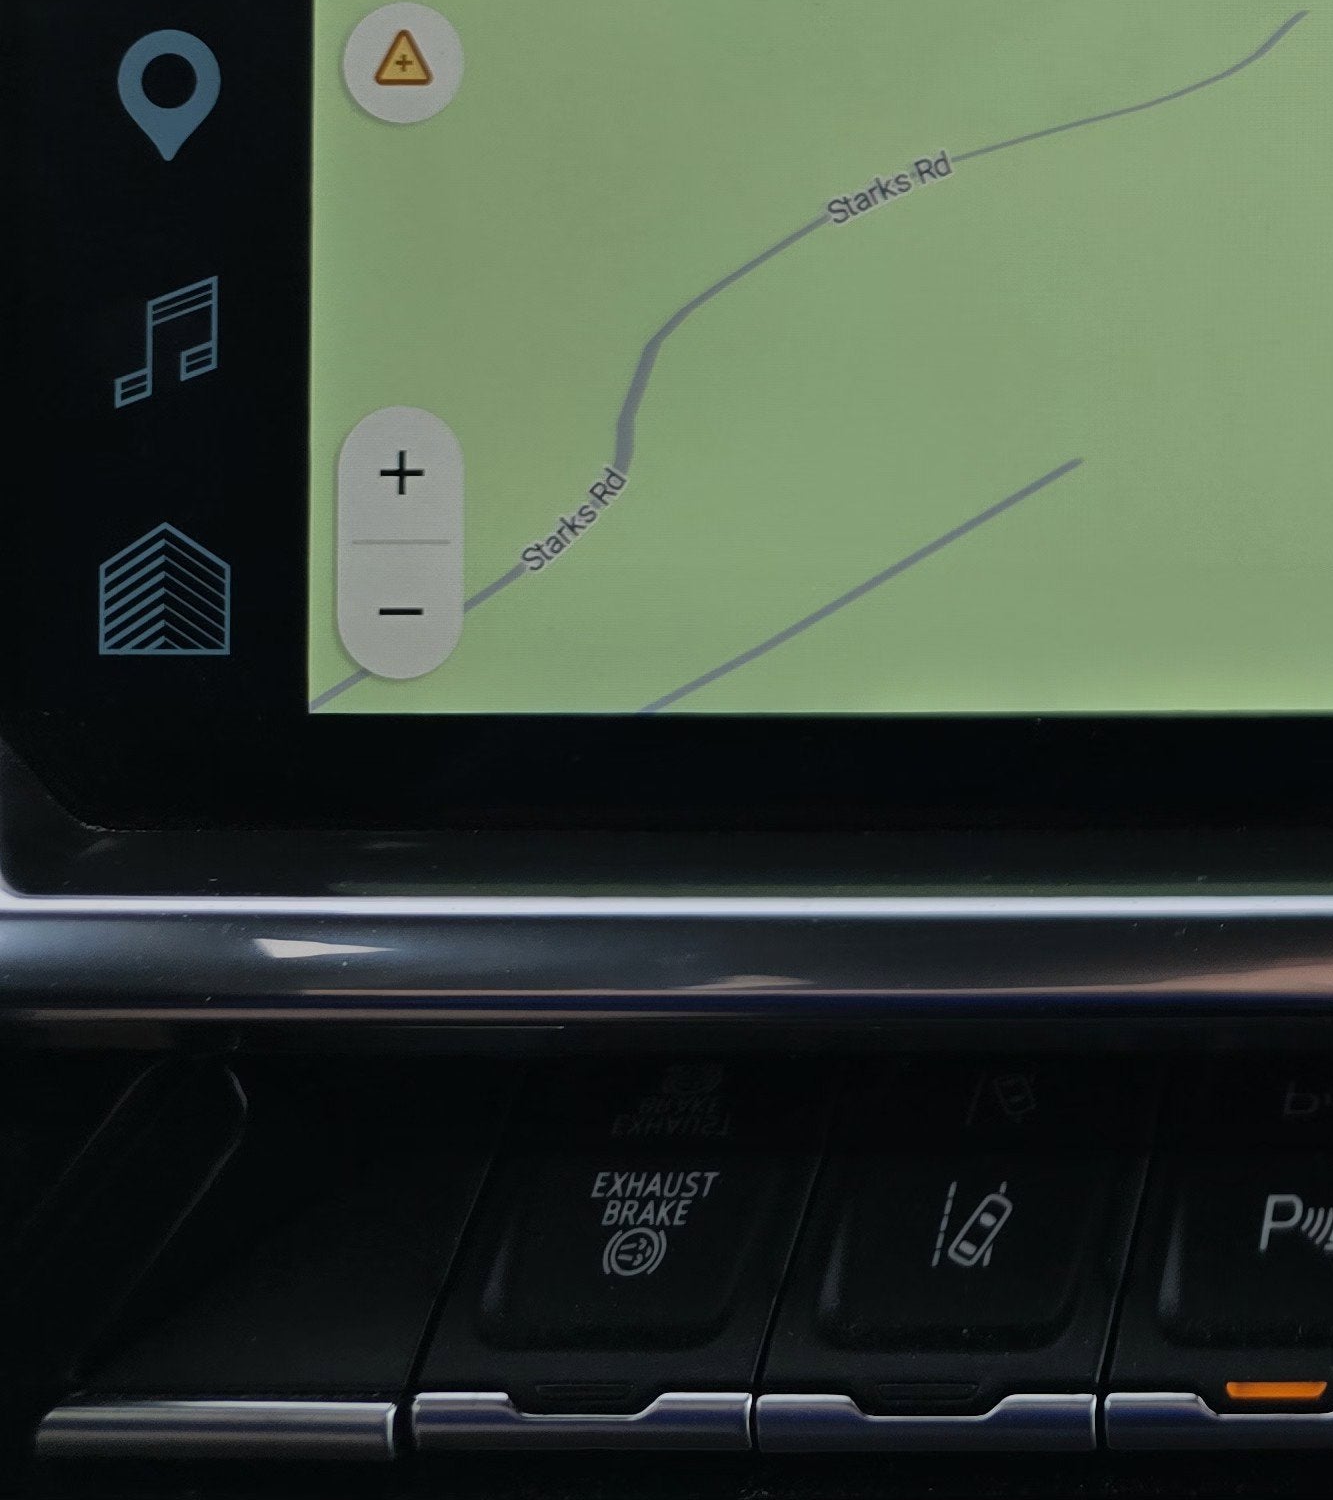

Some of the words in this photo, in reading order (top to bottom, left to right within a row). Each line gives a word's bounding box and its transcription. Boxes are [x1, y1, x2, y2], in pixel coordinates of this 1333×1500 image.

[827, 177, 912, 224] Starks
[913, 150, 953, 185] Rd
[521, 504, 598, 571] Starks
[589, 466, 627, 506] Rd
[590, 1171, 721, 1199] EXHAUST
[601, 1199, 693, 1227] BRAKE
